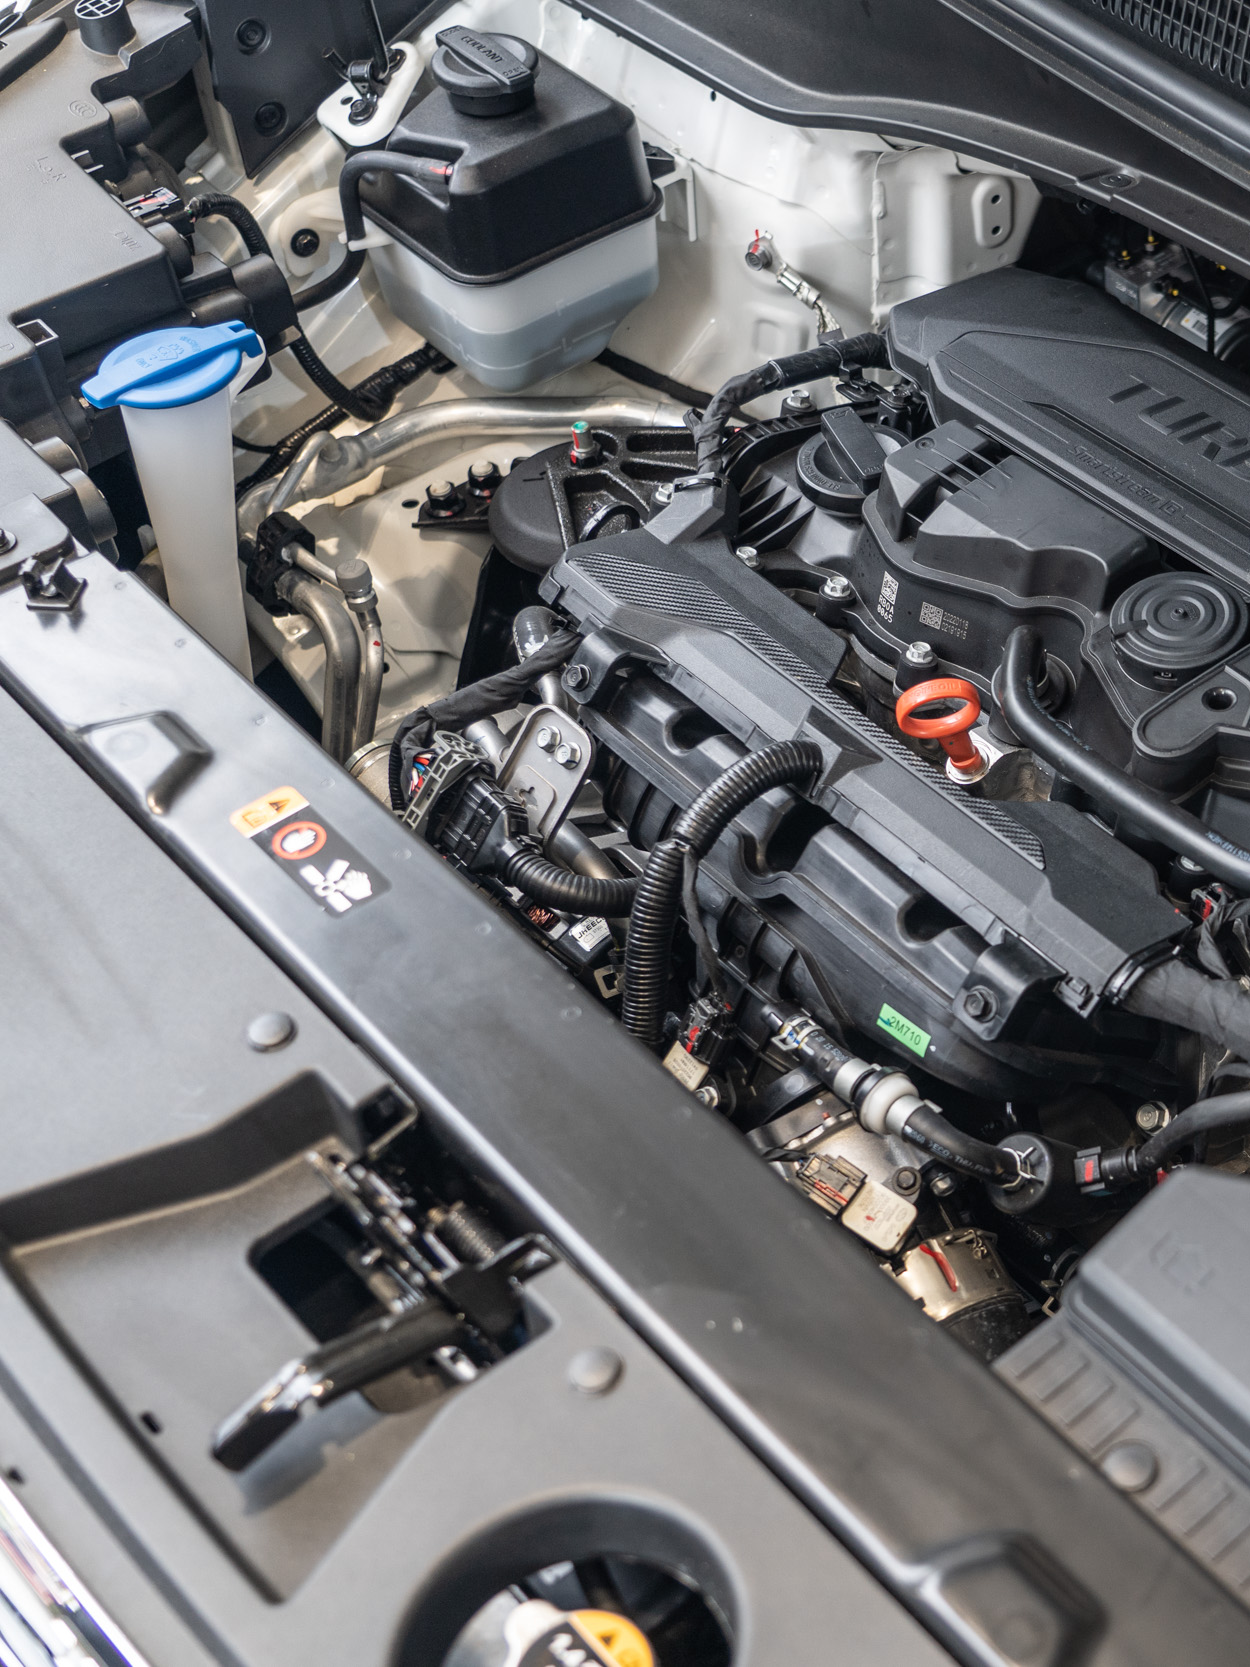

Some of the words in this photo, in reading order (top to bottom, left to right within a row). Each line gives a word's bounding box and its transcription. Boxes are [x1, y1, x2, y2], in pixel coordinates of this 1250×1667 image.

[460, 35, 504, 64] COOLANT
[1067, 444, 1162, 505] Smartstream
[578, 917, 606, 939] JHEEC
[889, 1015, 922, 1046] 2M710
